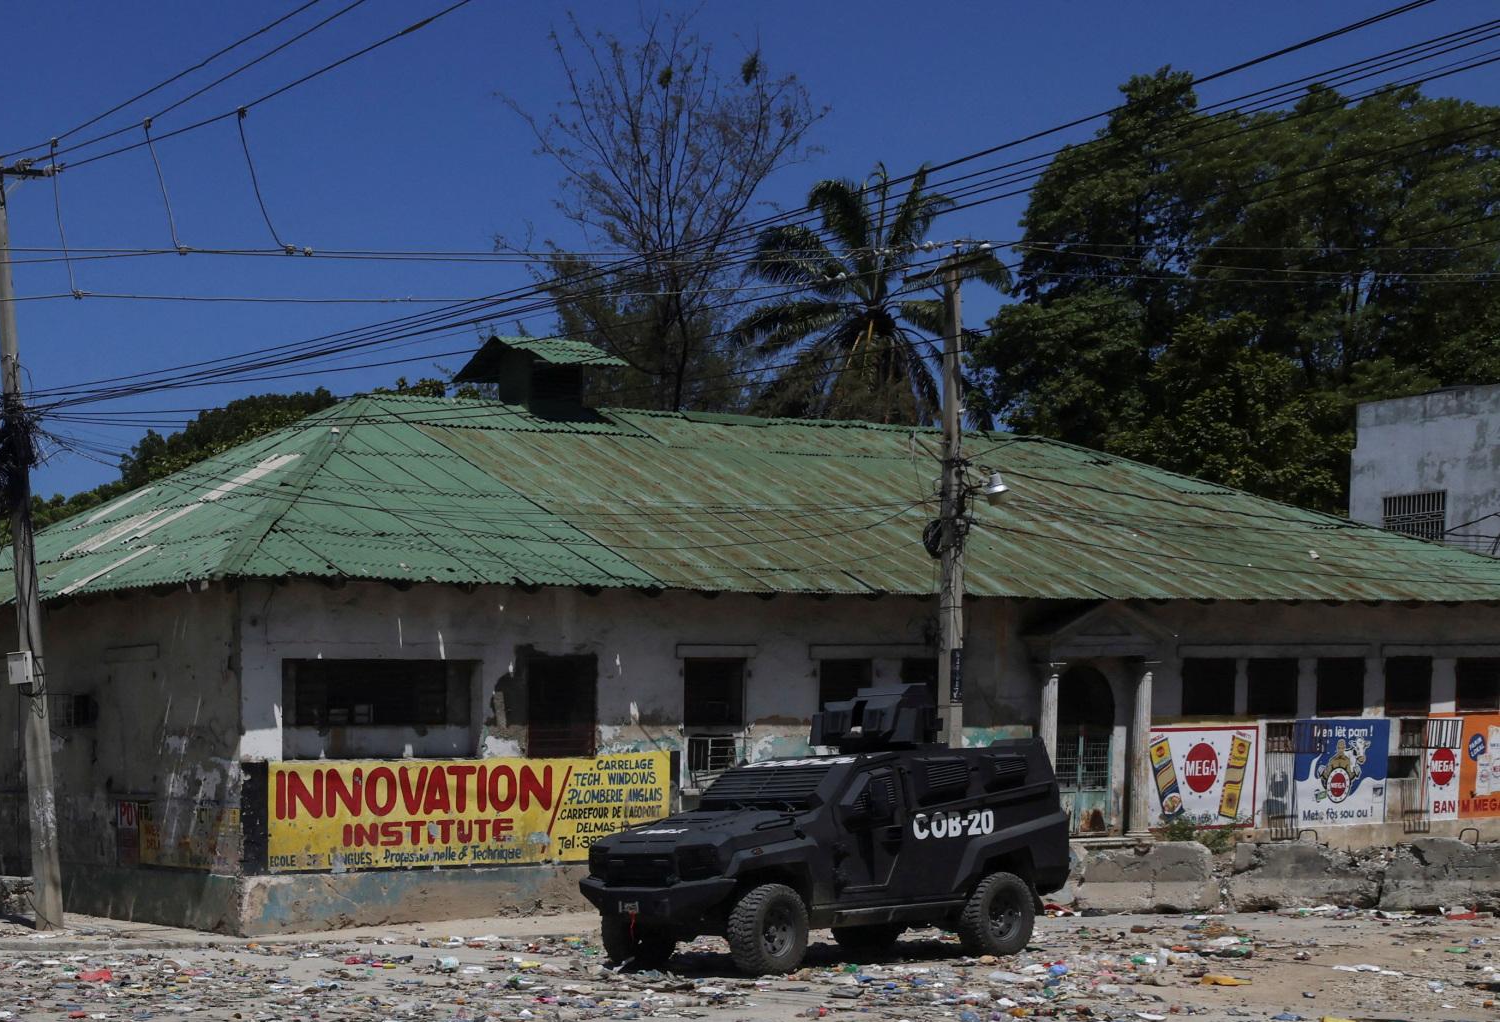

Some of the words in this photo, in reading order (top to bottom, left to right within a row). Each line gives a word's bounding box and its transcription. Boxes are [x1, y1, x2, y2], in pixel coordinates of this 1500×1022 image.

[596, 758, 654, 771] CARRELAGE
[1185, 759, 1217, 777] MEGA
[1431, 759, 1455, 774] MEGA
[608, 770, 656, 786] WINDOWS
[275, 764, 553, 820] INNOVATION
[568, 788, 623, 805] PLOMBERIE
[560, 806, 609, 821] CARREFOUR
[612, 806, 621, 818] DE
[342, 818, 514, 847] INSTITUTE
[576, 822, 616, 834] DELMAS
[912, 808, 995, 841] COB-20
[269, 855, 296, 867] ECOLE
[328, 851, 373, 867] LNGUES
